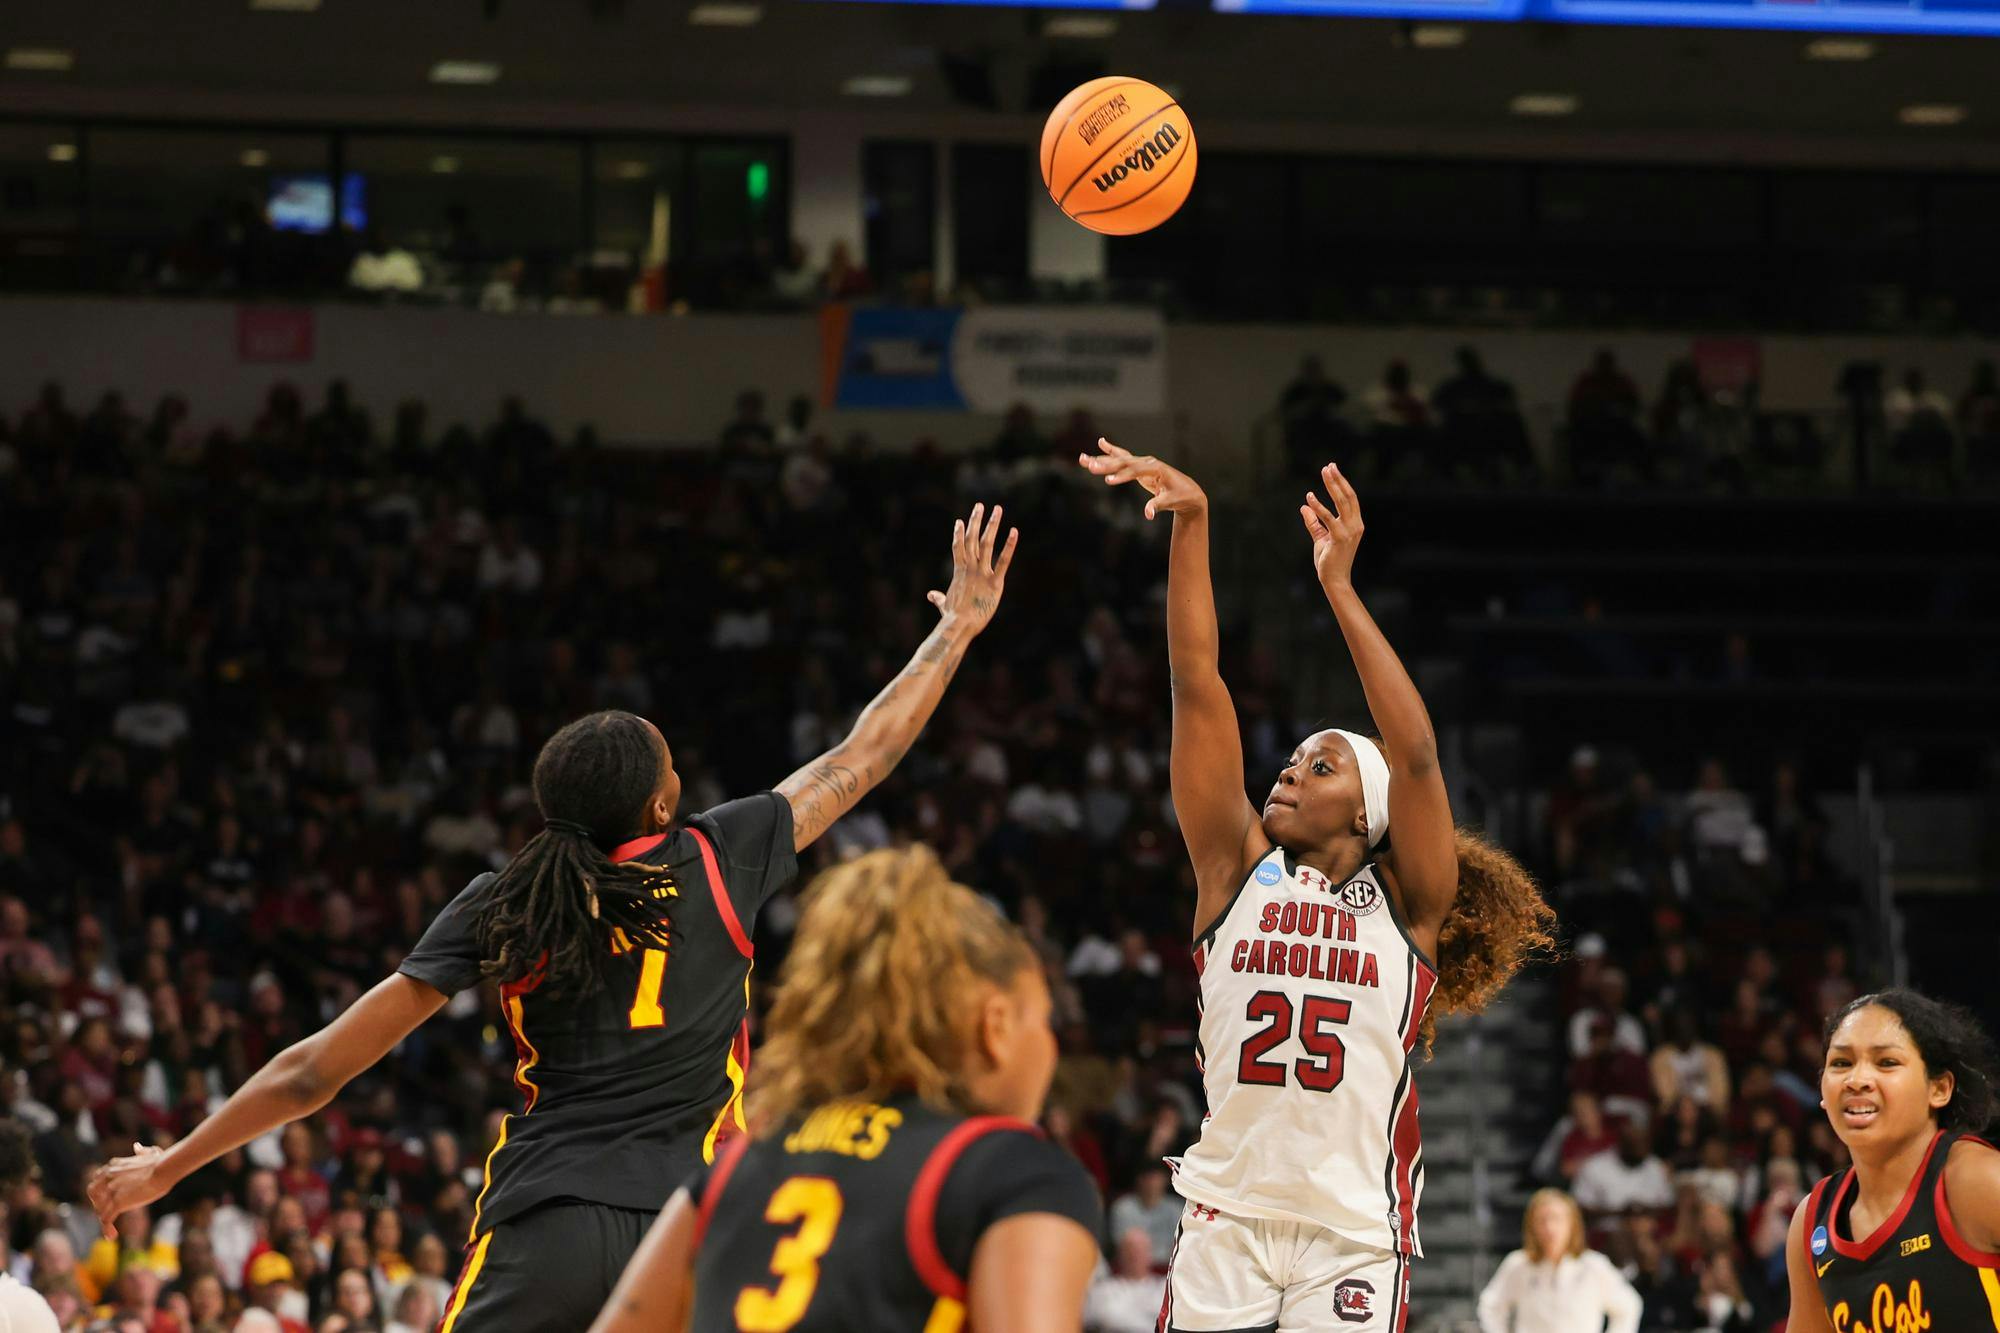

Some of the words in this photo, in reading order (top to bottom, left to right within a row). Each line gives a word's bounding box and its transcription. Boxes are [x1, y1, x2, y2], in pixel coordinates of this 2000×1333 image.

[1091, 122, 1182, 192] Wilson
[1341, 901, 1379, 915] GRADUATE
[1343, 881, 1374, 908] SEC
[1259, 902, 1357, 942] SOUTH
[1231, 939, 1379, 988] CAROLINA
[1238, 989, 1352, 1093] 25
[734, 1174, 845, 1333] 3
